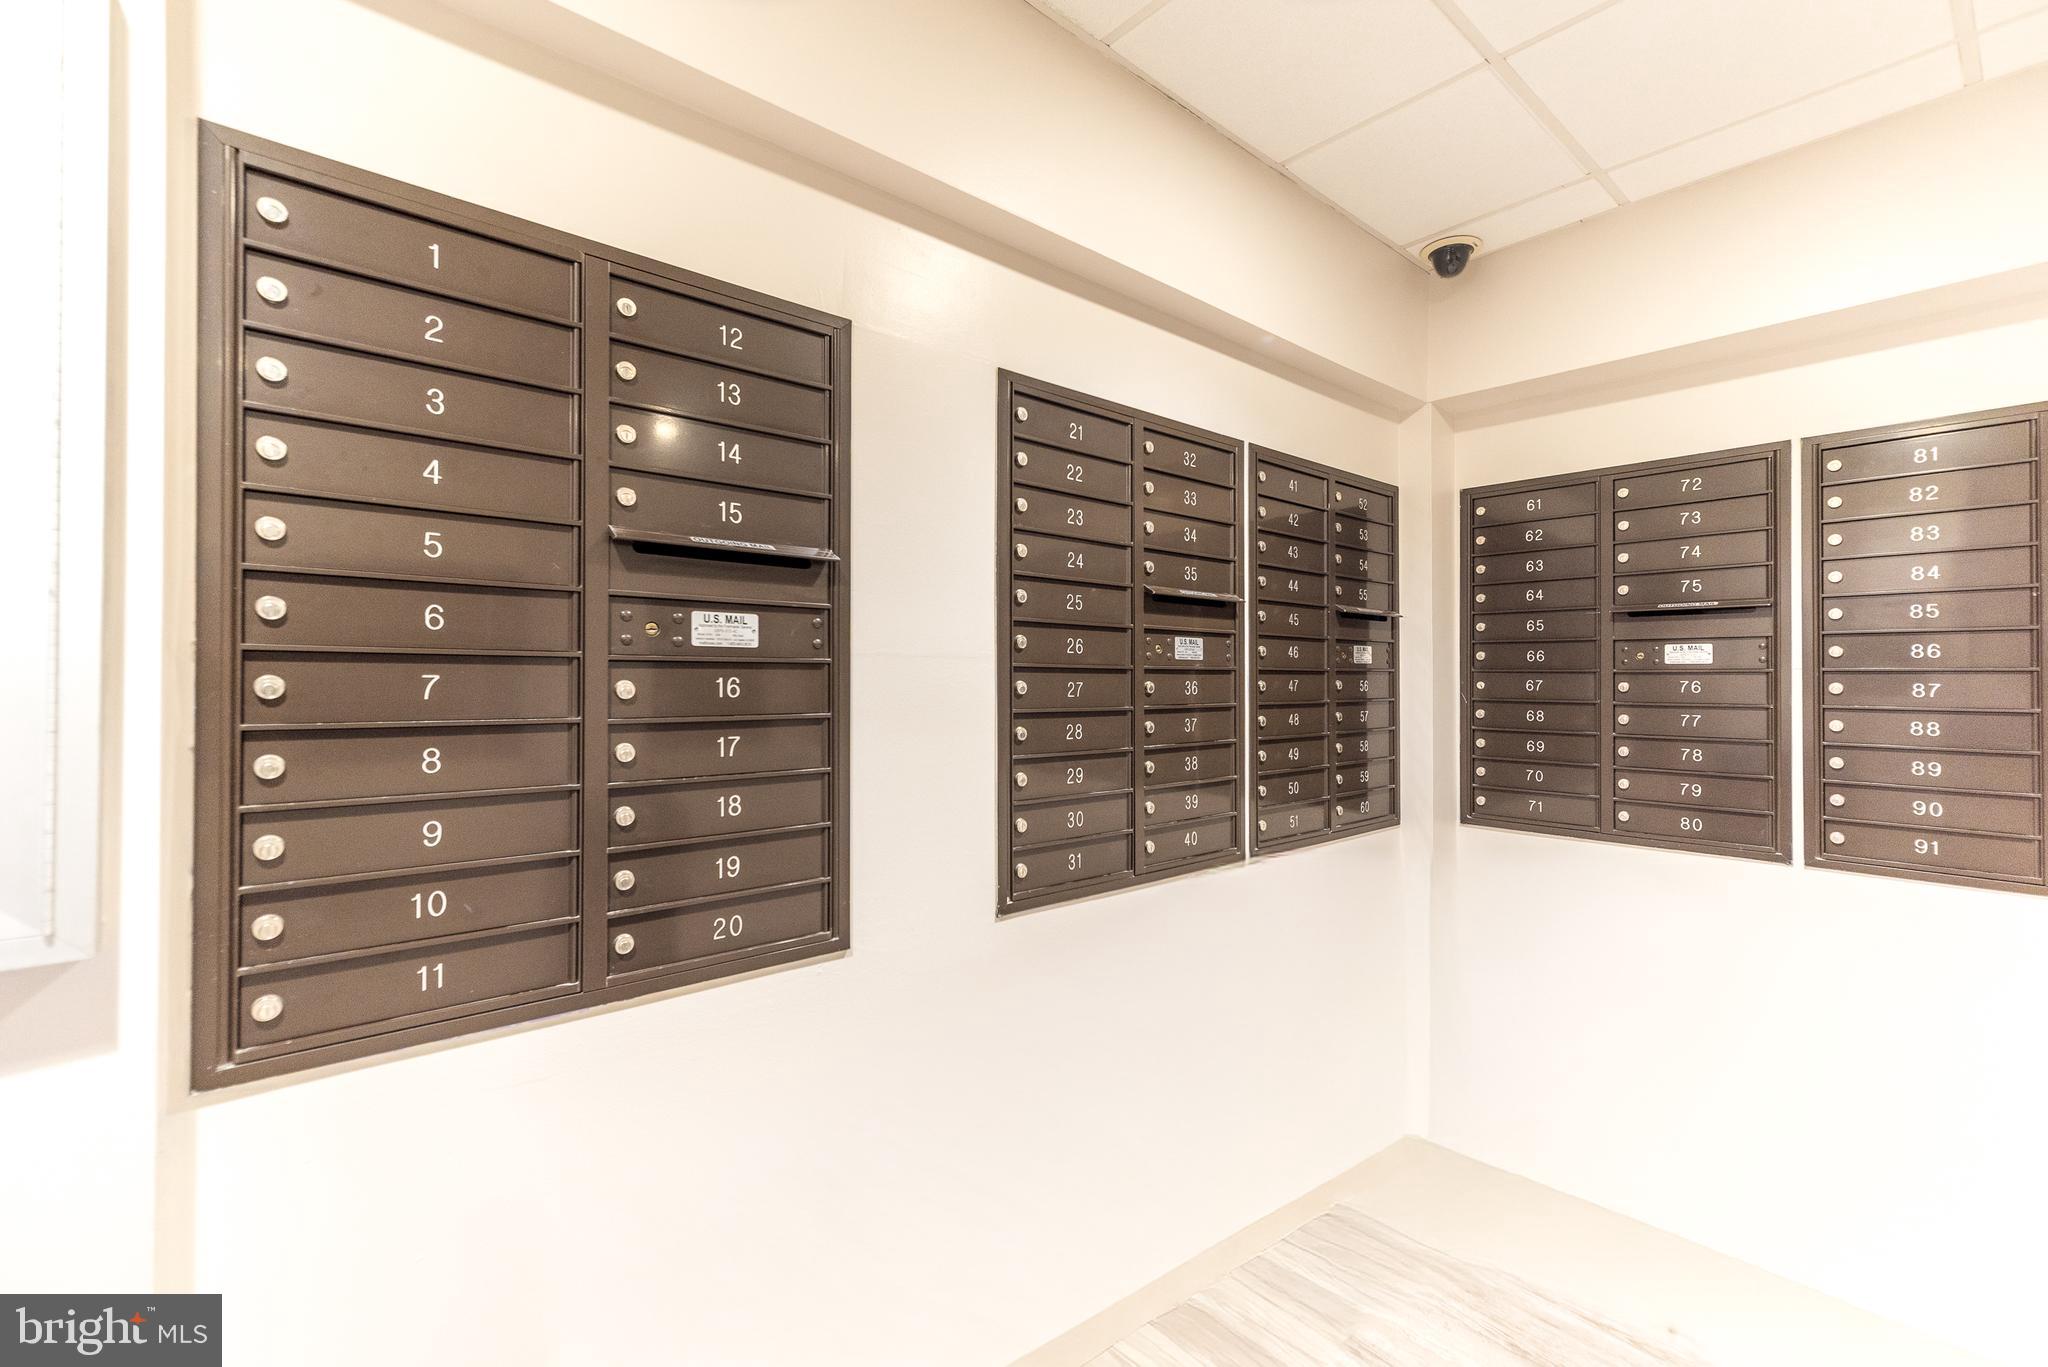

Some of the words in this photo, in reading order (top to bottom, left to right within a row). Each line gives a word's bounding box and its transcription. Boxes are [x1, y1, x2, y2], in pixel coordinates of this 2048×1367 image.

[428, 243, 440, 270] 1
[424, 315, 444, 343] 2
[719, 323, 743, 350] 12
[716, 379, 741, 406] 13
[425, 388, 445, 415] 3
[1069, 422, 1083, 441] 21
[717, 440, 742, 465] 14
[1183, 451, 1197, 468] 32
[1913, 445, 1938, 464] 81
[422, 459, 443, 485] 4
[1066, 463, 1083, 483] 22
[1288, 479, 1298, 493] 41
[1680, 477, 1702, 492] 72
[1183, 489, 1197, 506] 33
[1908, 484, 1939, 502] 82
[718, 500, 743, 524] 15
[1358, 497, 1368, 511] 52
[1526, 498, 1541, 511] 61
[1067, 508, 1084, 526] 23
[1288, 513, 1299, 527] 42
[1680, 510, 1701, 526] 73
[1183, 527, 1197, 543] 34
[1359, 528, 1369, 541] 53
[1525, 528, 1543, 542] 62
[1909, 524, 1940, 542] 83
[423, 531, 443, 558] 5
[1287, 545, 1299, 559] 43
[1680, 544, 1702, 559] 74
[1067, 551, 1084, 569] 24
[1359, 559, 1369, 571] 54
[1525, 559, 1544, 573] 63
[1184, 566, 1198, 582] 35
[1910, 564, 1941, 581] 84
[1288, 579, 1299, 592] 44
[1680, 579, 1703, 593] 75
[1066, 593, 1083, 611] 25
[1358, 588, 1368, 601] 55
[1526, 589, 1544, 602] 64
[424, 604, 445, 631] 6
[703, 613, 722, 624] U.S.
[725, 615, 748, 625] MAIL
[1909, 603, 1940, 619] 85
[1288, 613, 1300, 626] 45
[1526, 619, 1545, 632] 65
[1066, 637, 1084, 655] 26
[1287, 645, 1299, 659] 46
[1910, 643, 1942, 659] 86
[1526, 649, 1545, 662] 66
[421, 674, 441, 700] 7
[715, 676, 741, 699] 16
[1067, 681, 1084, 698] 27
[1184, 680, 1198, 696] 36
[1288, 679, 1299, 692] 47
[1359, 679, 1369, 692] 56
[1525, 679, 1544, 692] 67
[1679, 680, 1702, 694] 76
[1911, 682, 1942, 698] 87
[1288, 713, 1300, 726] 48
[1359, 710, 1369, 723] 57
[1526, 709, 1545, 722] 68
[1680, 714, 1702, 728] 77
[1066, 723, 1083, 740] 28
[1184, 717, 1198, 733] 37
[1909, 720, 1941, 737] 88
[716, 735, 741, 758] 17
[1359, 739, 1369, 752] 58
[1526, 740, 1545, 753] 69
[421, 747, 442, 774] 8
[1288, 747, 1299, 761] 49
[1680, 748, 1703, 762] 78
[1184, 755, 1199, 771] 38
[1911, 760, 1942, 777] 89
[1066, 767, 1084, 785] 29
[1359, 770, 1370, 783] 59
[1526, 769, 1544, 782] 70
[1288, 781, 1300, 795] 50
[1680, 782, 1702, 797] 79
[716, 794, 742, 818] 18
[1185, 794, 1199, 810] 39
[1360, 800, 1370, 814] 60
[1528, 799, 1543, 813] 71
[1912, 800, 1944, 818] 90
[1067, 810, 1084, 829] 30
[1289, 815, 1299, 828] 51
[1680, 816, 1703, 832] 80
[422, 820, 443, 847] 9
[1184, 831, 1198, 847] 40
[1914, 838, 1939, 856] 91
[715, 855, 741, 879] 19
[1068, 852, 1082, 871] 31
[410, 890, 447, 919] 10
[713, 914, 743, 941] 20
[416, 962, 444, 992] 11
